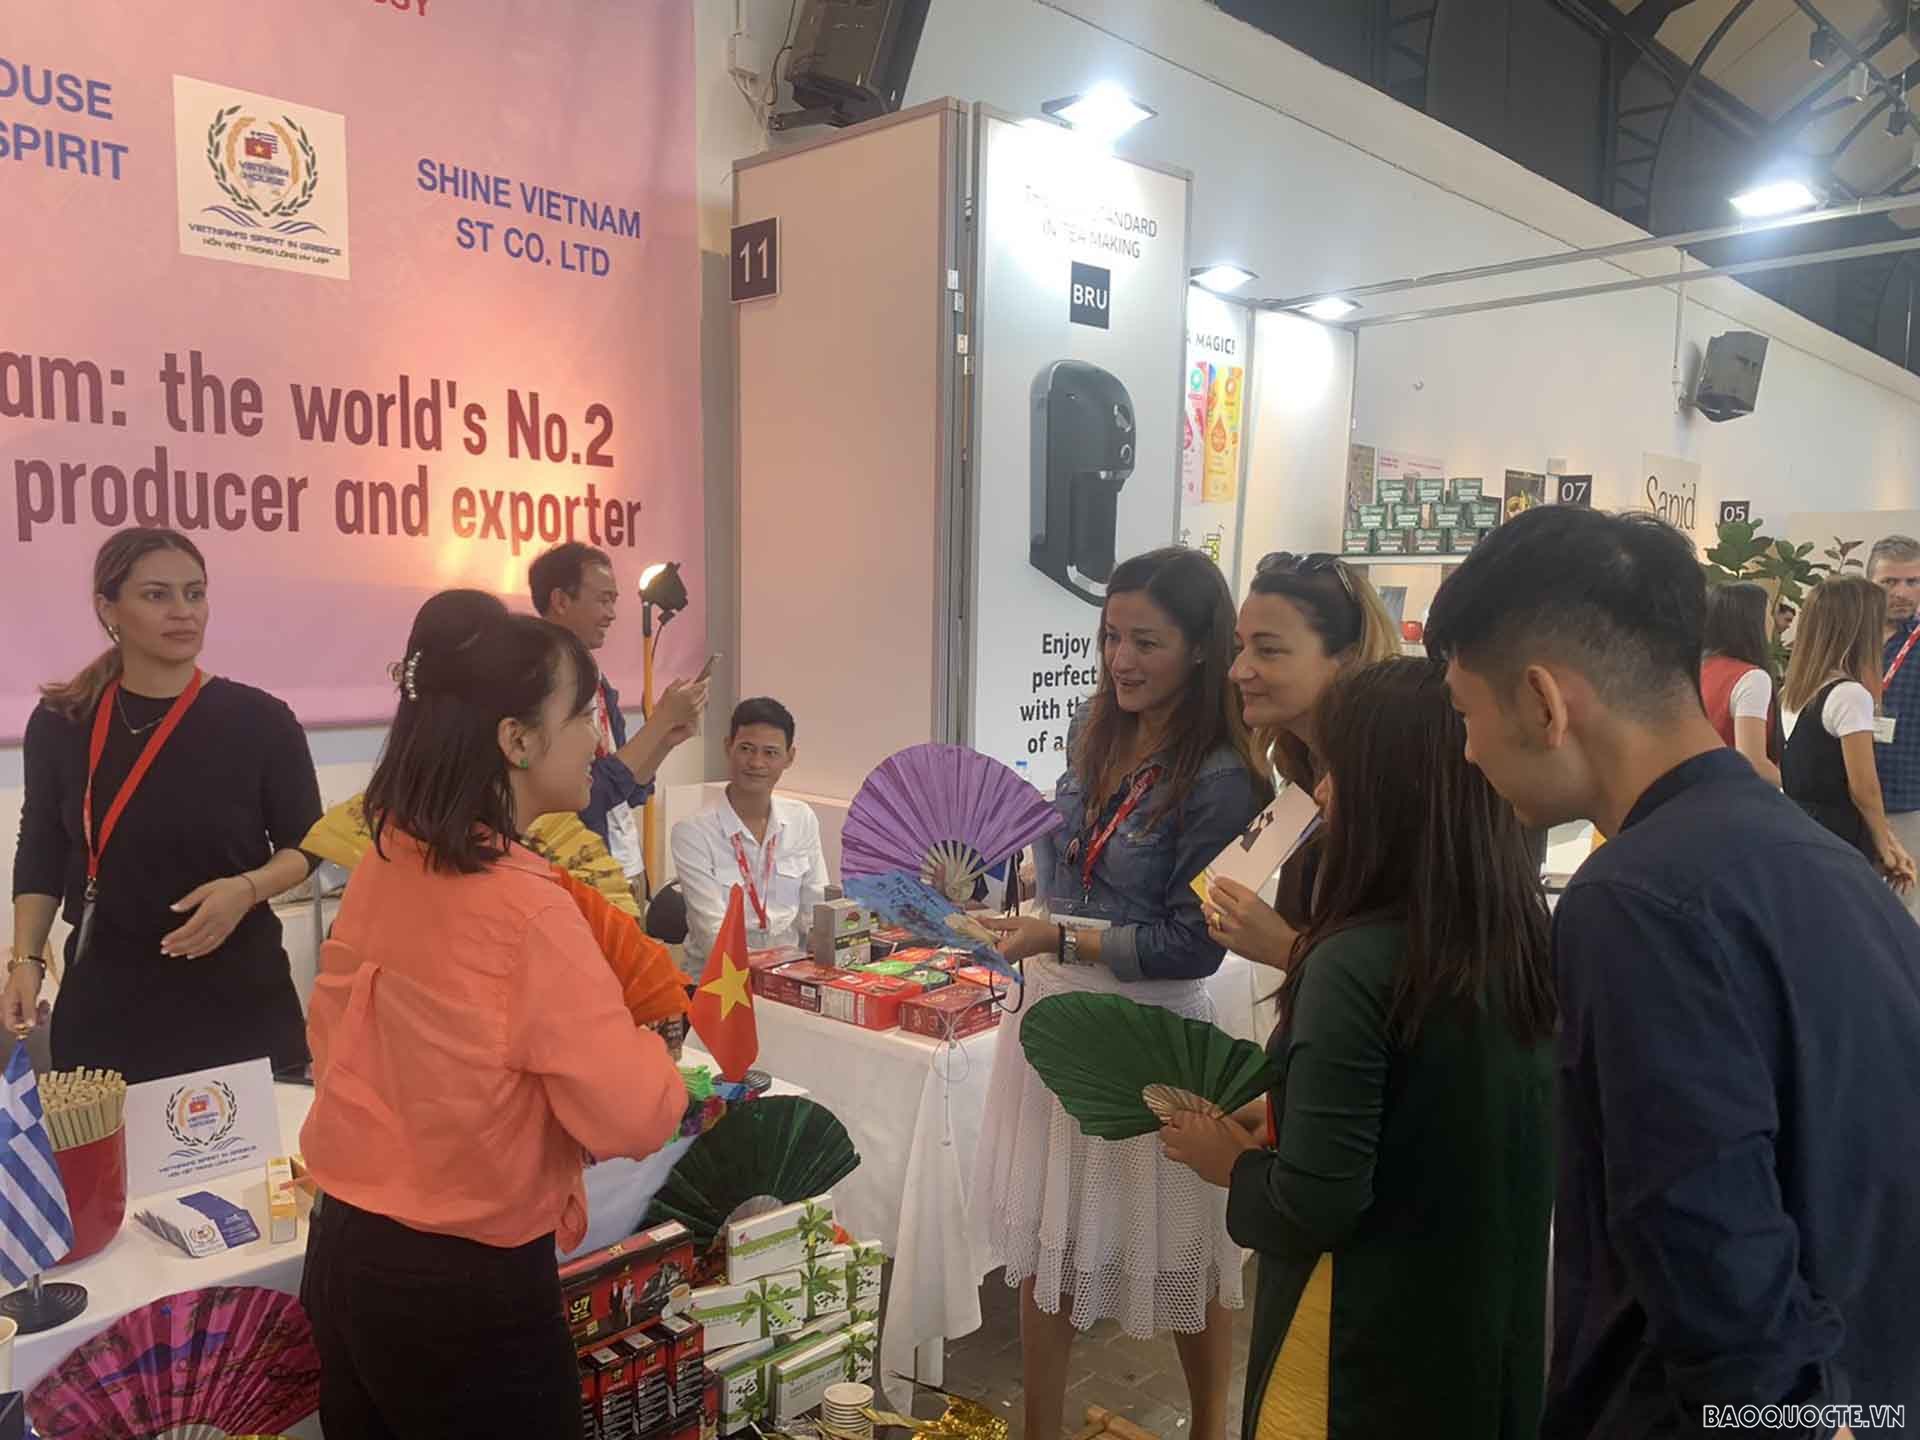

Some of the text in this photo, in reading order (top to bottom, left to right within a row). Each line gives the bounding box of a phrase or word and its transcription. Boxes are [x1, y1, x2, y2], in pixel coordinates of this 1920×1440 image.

[417, 158, 641, 239] SHINE VIETNAM
[456, 217, 610, 276] ST CO. LTD
[740, 237, 768, 283] 11
[1073, 284, 1108, 310] BRU
[1196, 333, 1236, 356] MAGIC!
[160, 350, 263, 437] the
[290, 374, 487, 456] world's
[507, 388, 615, 468] No.2
[14, 445, 641, 557] producer and exporter
[1561, 482, 1588, 502] 07
[1724, 506, 1746, 522] 05
[1042, 633, 1091, 660] Enjoy
[1032, 664, 1097, 693] perfect
[1020, 697, 1060, 721] with
[1027, 730, 1048, 754] of
